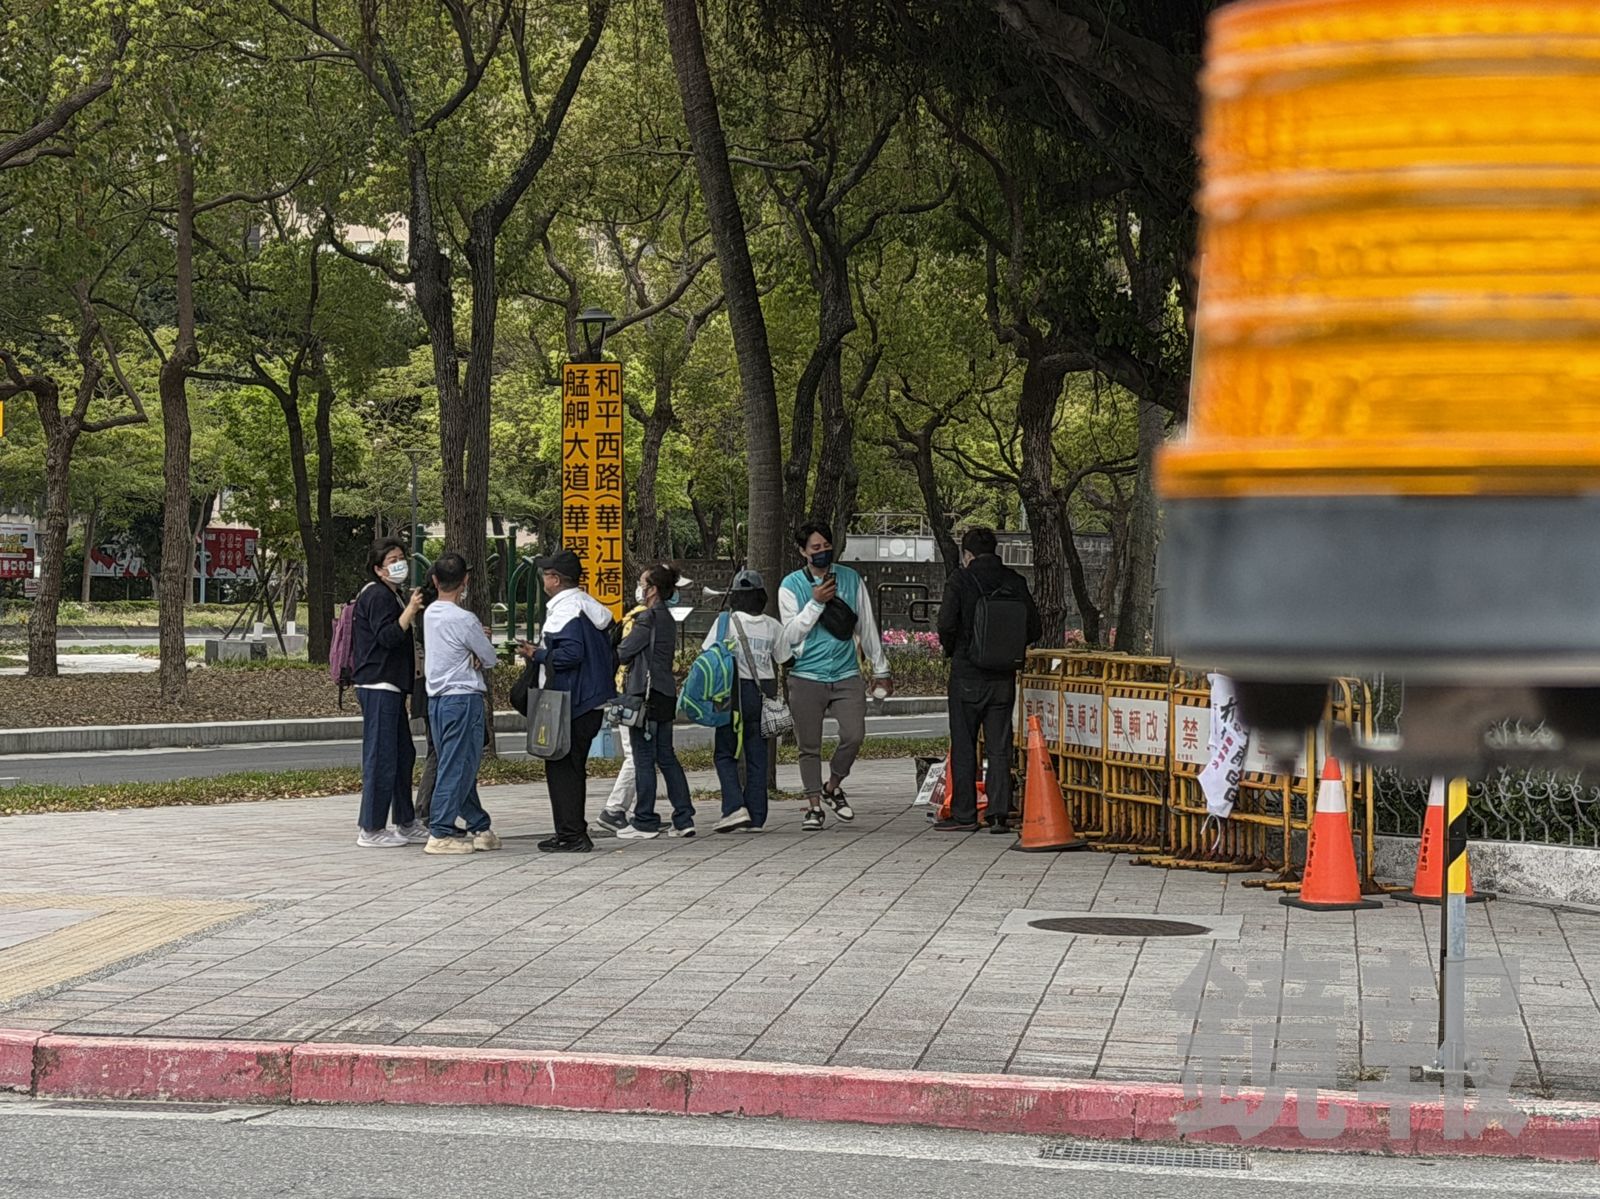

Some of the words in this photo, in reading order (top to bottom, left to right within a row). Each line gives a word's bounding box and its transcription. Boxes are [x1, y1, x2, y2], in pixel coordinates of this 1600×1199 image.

[1112, 707, 1168, 744] 車輛改
[1182, 716, 1199, 750] 禁
